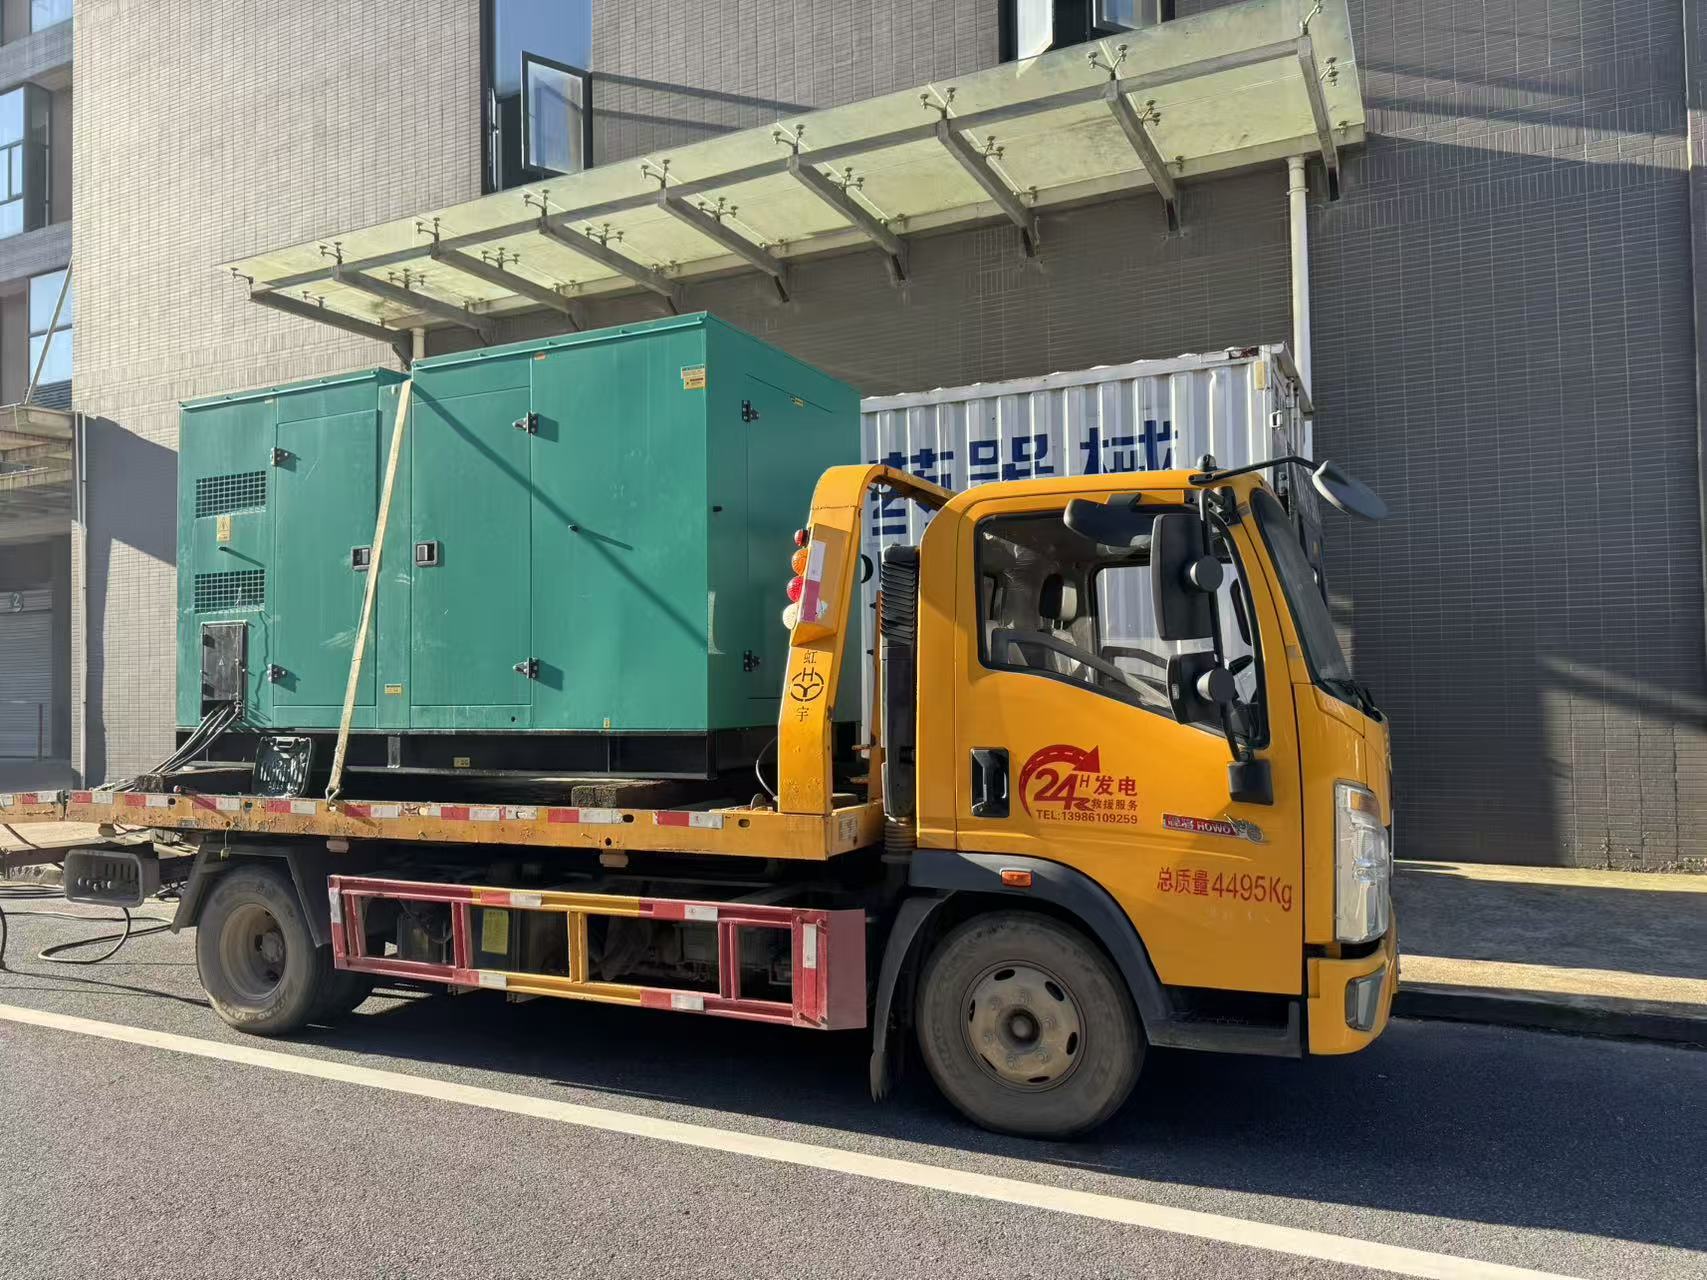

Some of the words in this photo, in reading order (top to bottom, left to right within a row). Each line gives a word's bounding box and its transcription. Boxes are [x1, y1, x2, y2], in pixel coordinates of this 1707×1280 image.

[804, 650, 817, 663] 虹
[796, 706, 809, 722] 宇
[1093, 775, 1138, 796] 发电
[1196, 820, 1231, 834] HOWO
